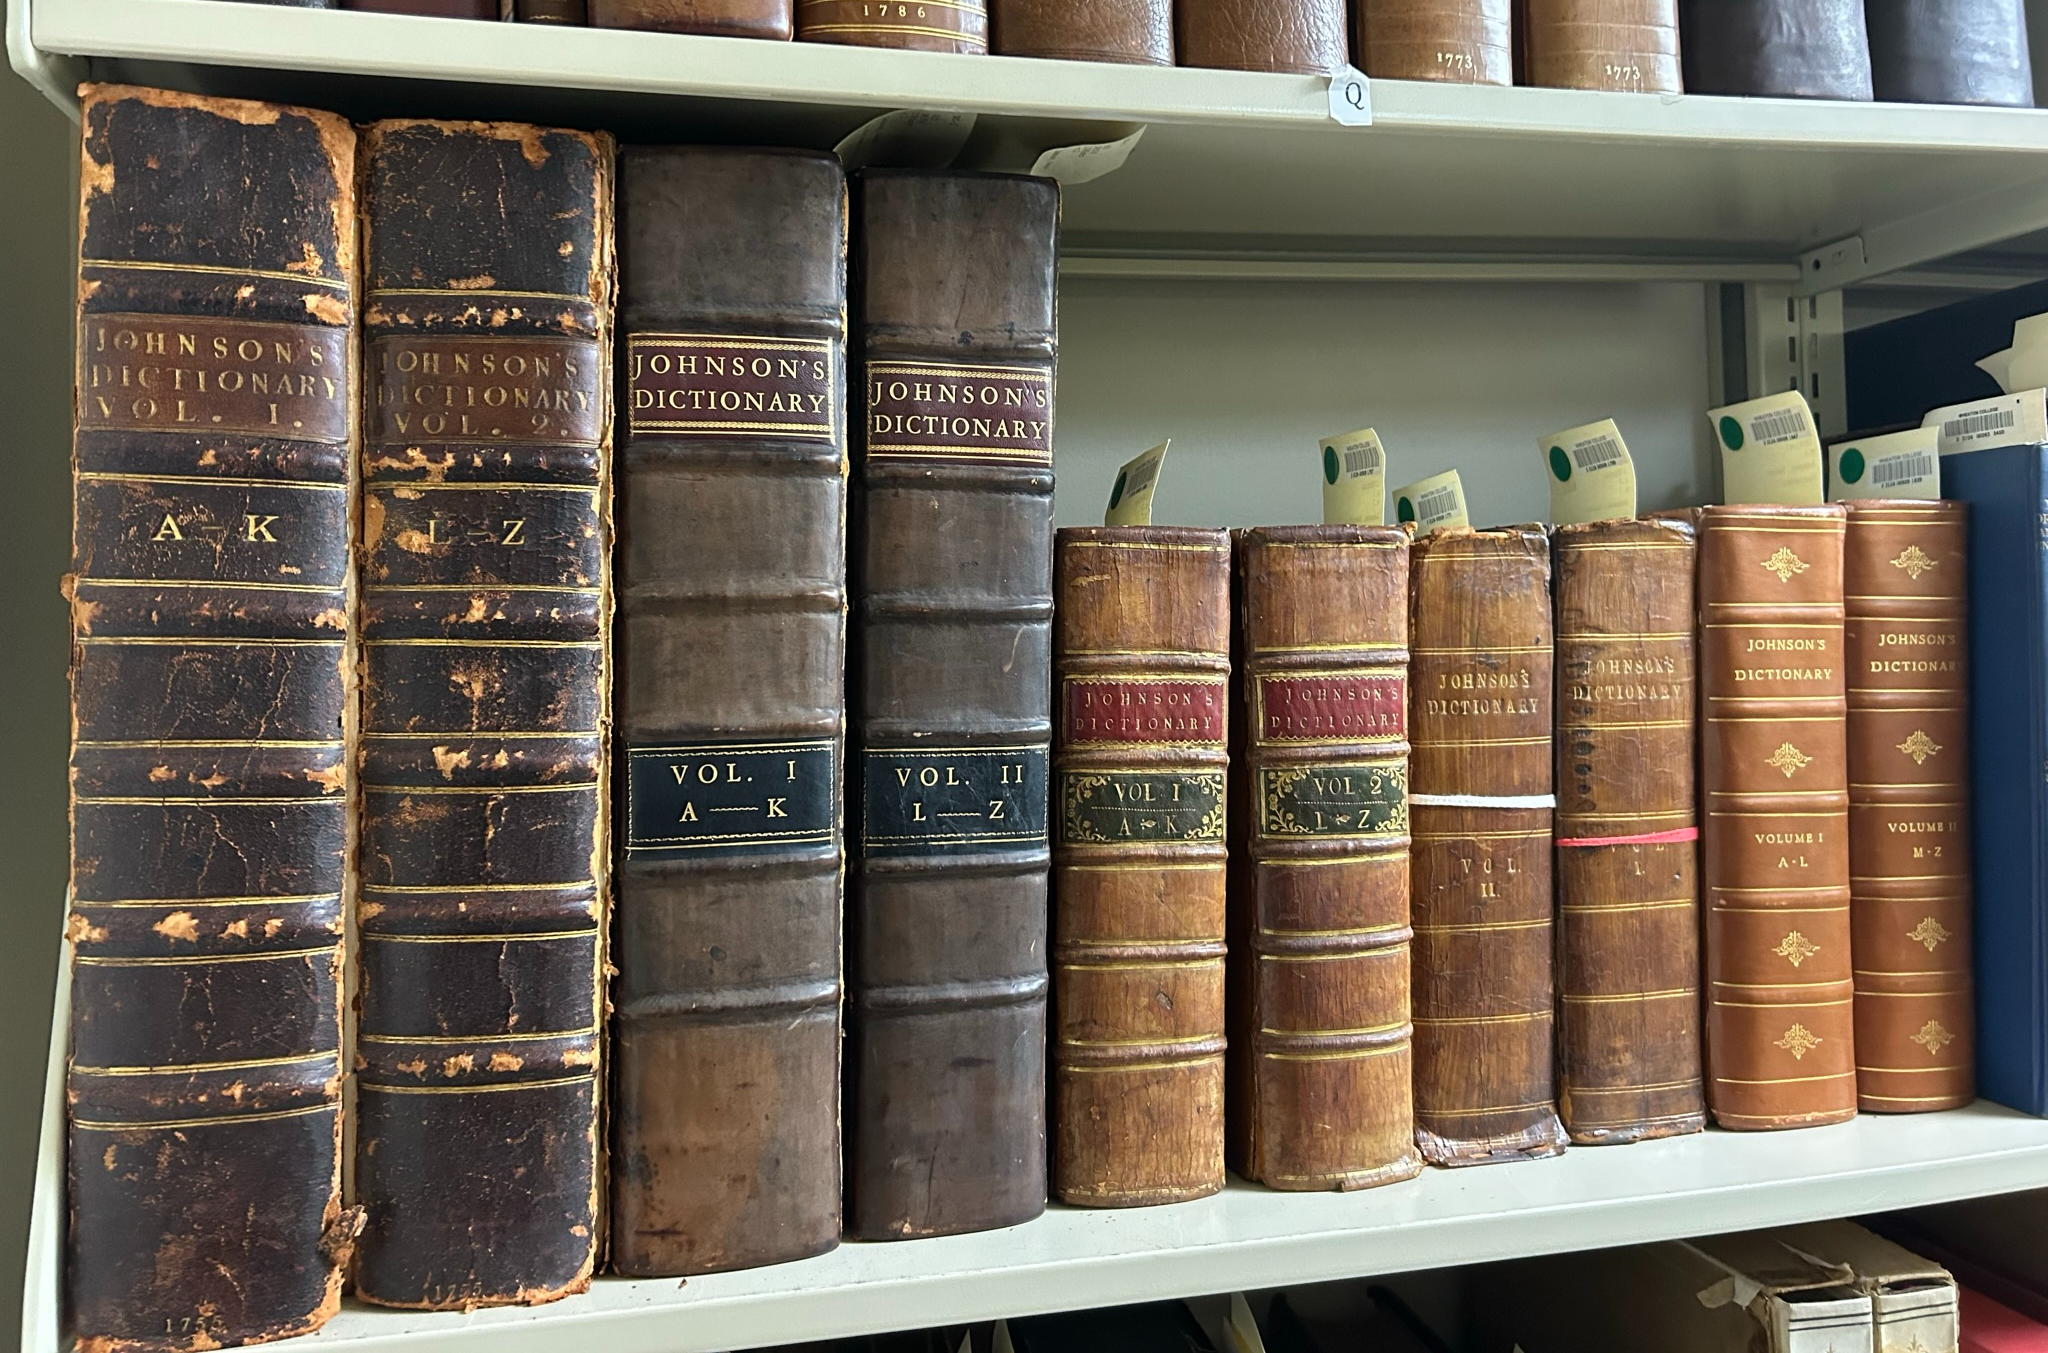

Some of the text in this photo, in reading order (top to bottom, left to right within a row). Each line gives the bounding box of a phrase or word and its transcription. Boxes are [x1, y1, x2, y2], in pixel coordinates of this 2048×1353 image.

[863, 4, 927, 19] 1786
[1436, 52, 1474, 70] 1773
[1605, 64, 1641, 81] 1773
[1344, 81, 1363, 111] Q
[96, 327, 323, 366] JOHNSON'S
[381, 351, 578, 378] JOHNSON'S
[634, 353, 825, 380] JOHNSON'S
[90, 364, 337, 400] DICTIONARY
[377, 384, 591, 414] DICTIONARY
[635, 388, 825, 415] DICTIONARY
[872, 381, 1047, 409] JOHNSON'S
[97, 396, 222, 424] VOL.
[396, 413, 569, 438] VOL. 2.
[873, 413, 1047, 441] DICTIONARY
[152, 514, 183, 541] A
[248, 514, 280, 542] K
[428, 519, 451, 545] L
[502, 519, 526, 545] Z
[1747, 639, 1826, 652] JOHNSON'S
[1734, 668, 1833, 681] DICTIONARY
[1870, 660, 1962, 673] DICTIONAR
[1439, 669, 1530, 690] JOHNSON'S
[1286, 687, 1398, 703] JOHNSON'S
[1573, 683, 1682, 701] DICTIONARY
[1427, 698, 1540, 716] DICTIONARY
[1075, 717, 1214, 731] DICTIONARY
[1271, 713, 1400, 729] DICTIONARY
[671, 760, 797, 786] VOL. I
[896, 764, 1024, 788] VOL. II
[1113, 783, 1157, 803] VOL
[1313, 776, 1383, 796] VOL 2
[679, 797, 788, 823] A K
[912, 800, 1006, 823] L Z
[1358, 809, 1369, 829] Z
[1117, 815, 1179, 836] A K
[1888, 822, 1944, 834] VOLUME
[1755, 833, 1824, 845] VOLUME I
